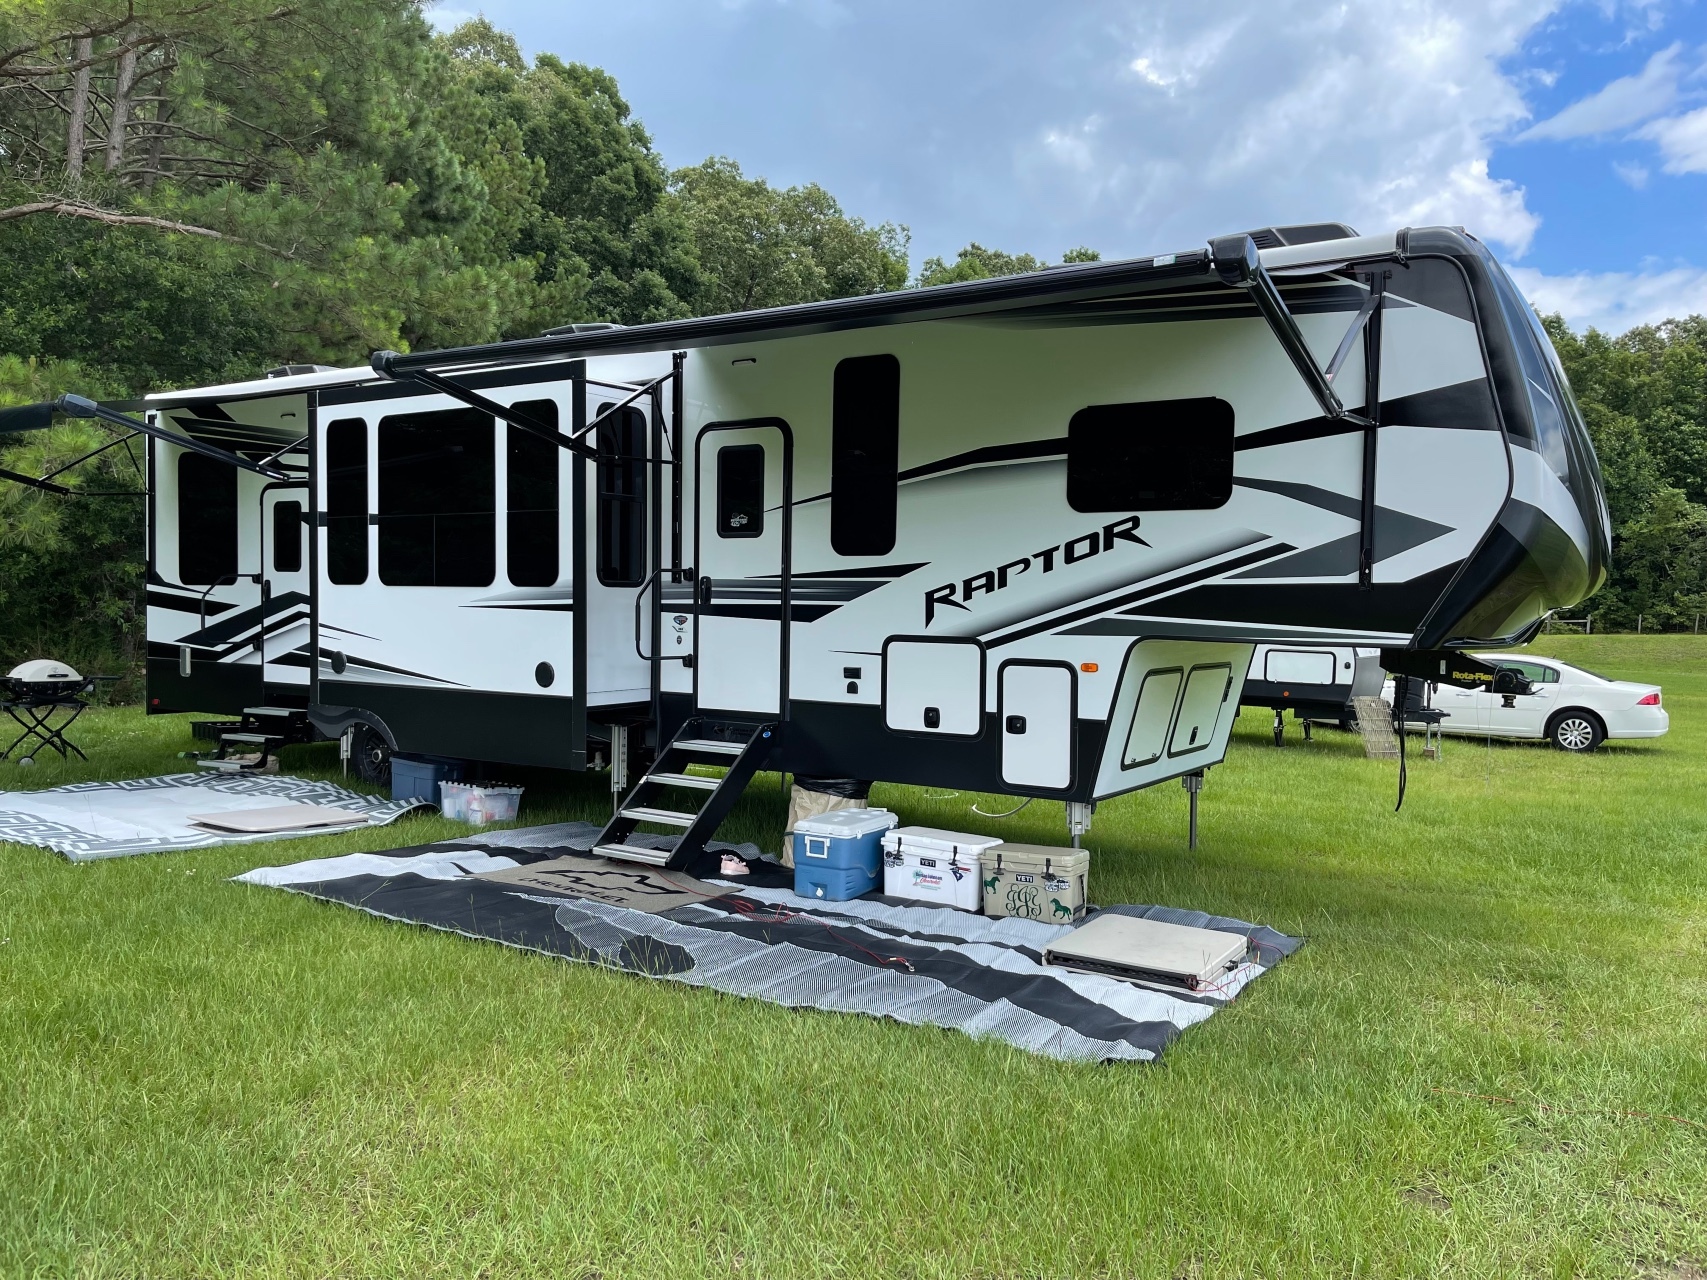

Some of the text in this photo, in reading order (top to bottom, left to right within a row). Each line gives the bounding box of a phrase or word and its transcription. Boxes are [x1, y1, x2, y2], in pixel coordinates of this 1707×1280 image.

[925, 515, 1153, 629] RAPTOR
[1453, 671, 1494, 681] Rota-Flex
[921, 858, 935, 867] YETI
[1016, 875, 1033, 883] YETI
